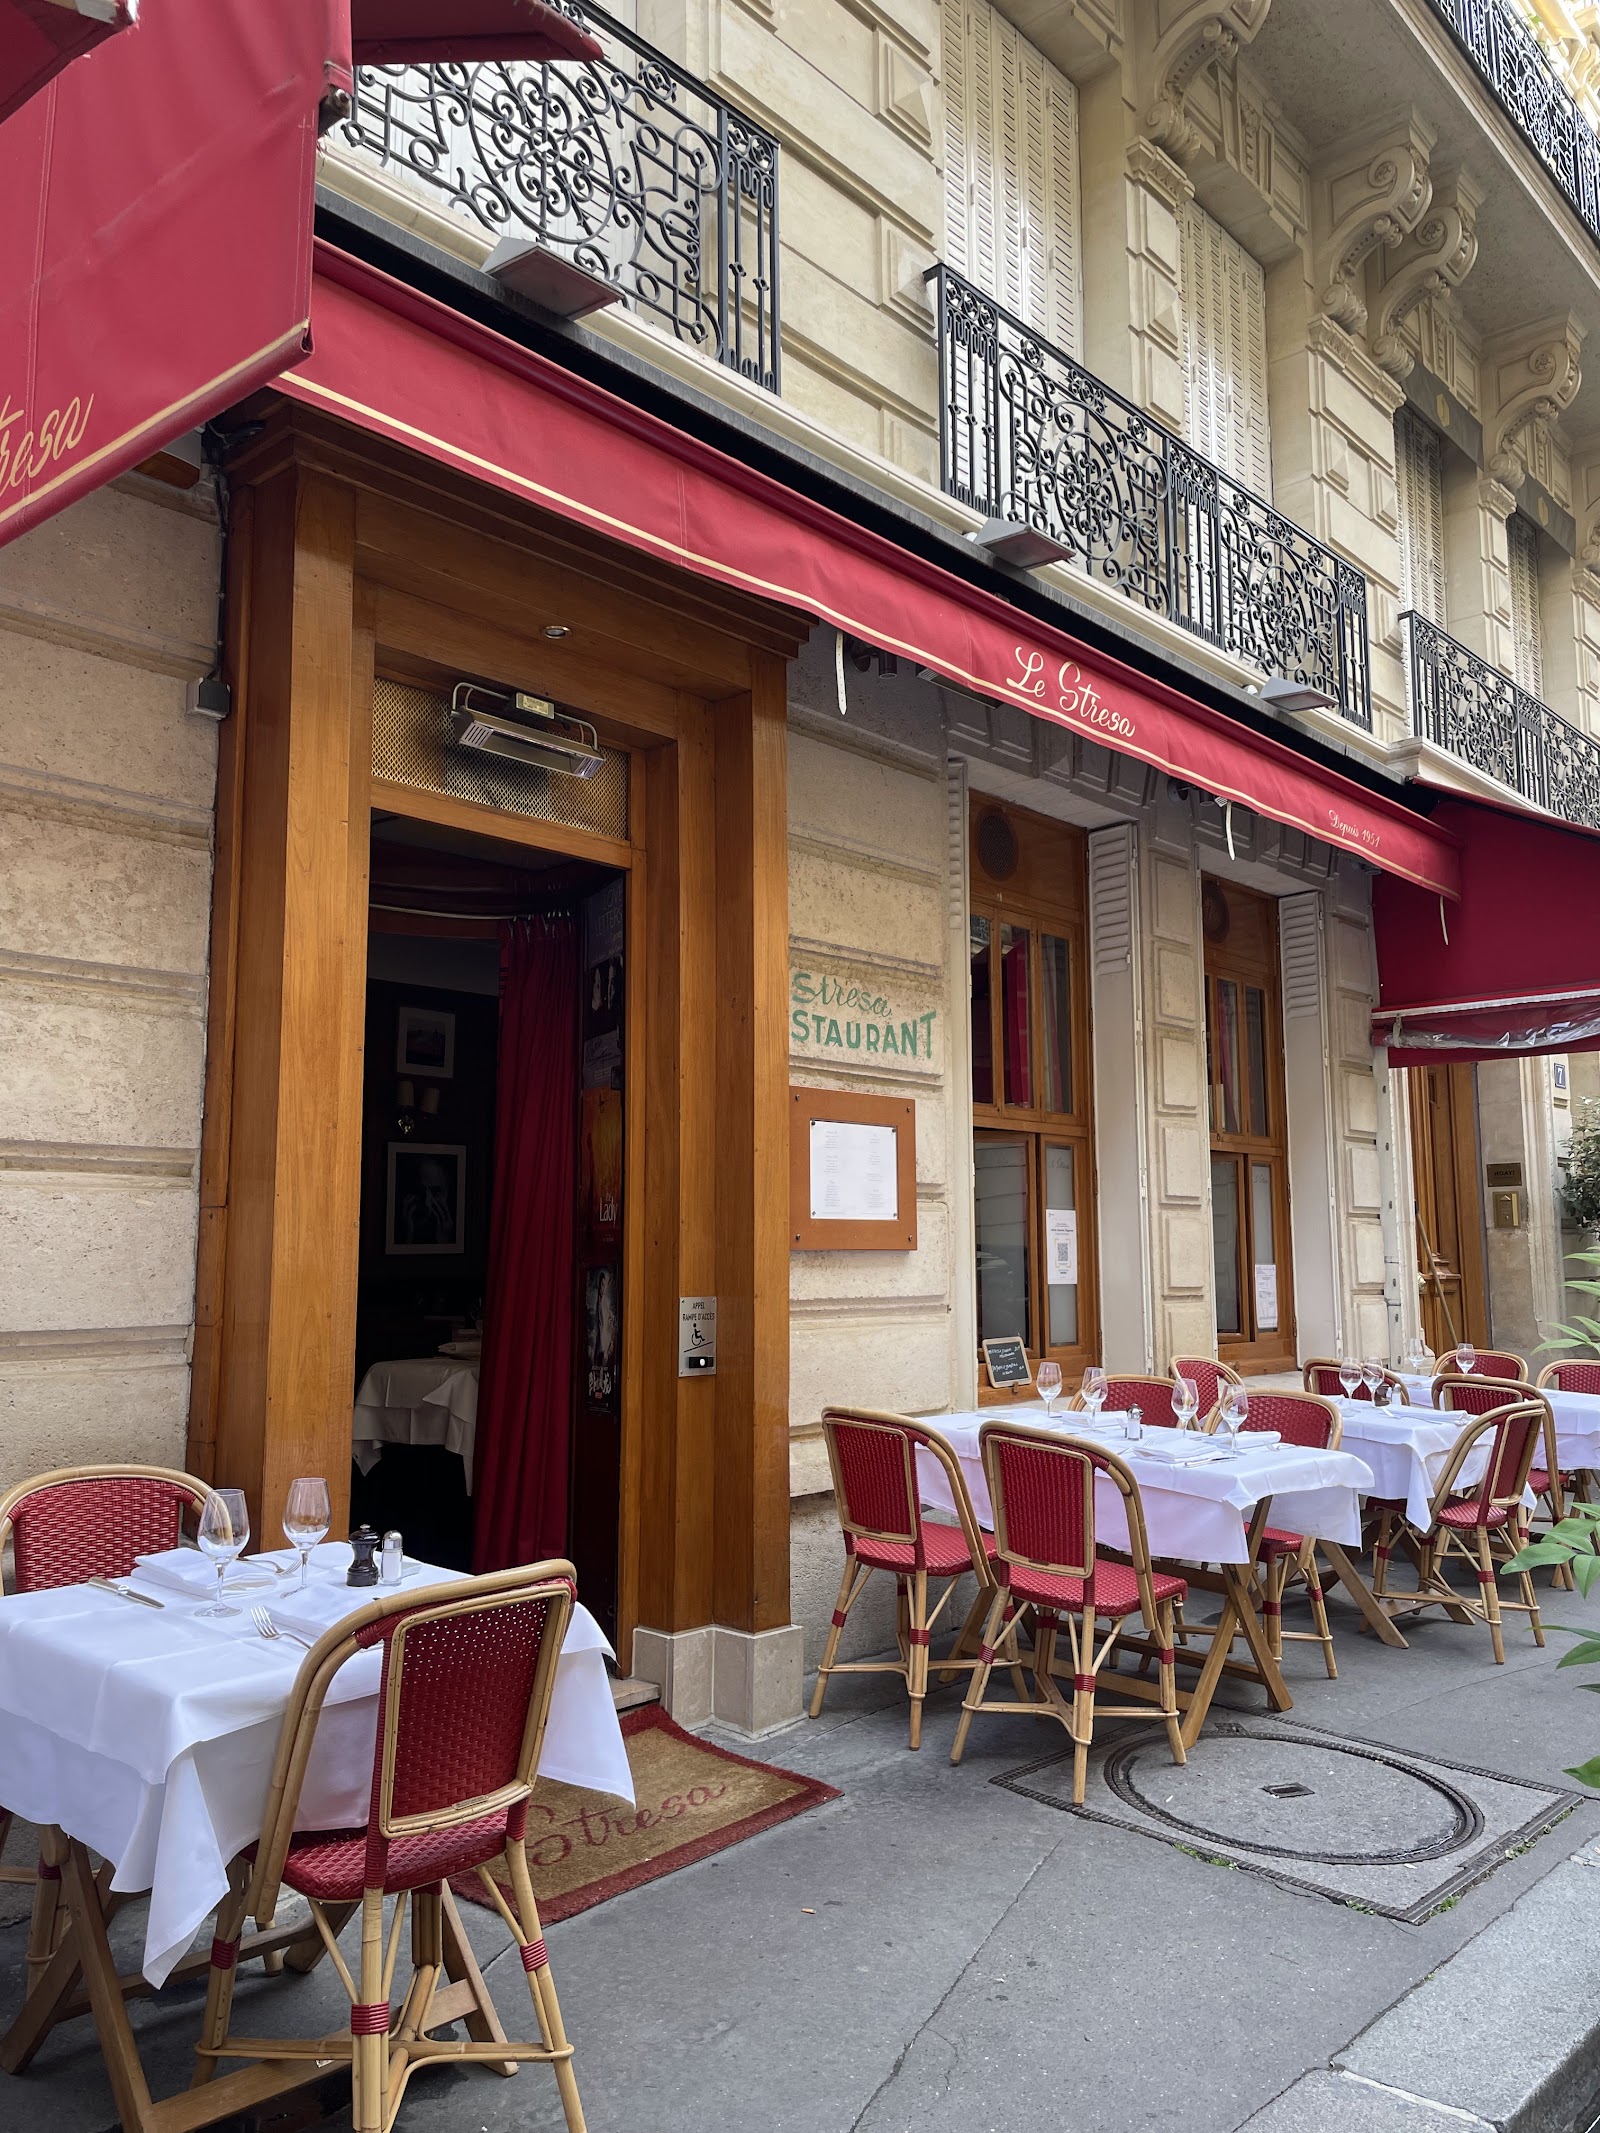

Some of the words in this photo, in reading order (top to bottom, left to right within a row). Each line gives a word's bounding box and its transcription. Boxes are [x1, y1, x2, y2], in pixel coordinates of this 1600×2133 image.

[1006, 646, 1046, 698] Le
[1058, 661, 1136, 737] Stresa
[1328, 809, 1360, 837] Depuis
[1362, 829, 1381, 848] 1951
[791, 972, 893, 1018] Stresa
[791, 1009, 937, 1059] STAURANT
[1557, 1067, 1563, 1084] 7
[600, 1196, 619, 1229] Lady
[526, 1782, 728, 1867] Stresa
